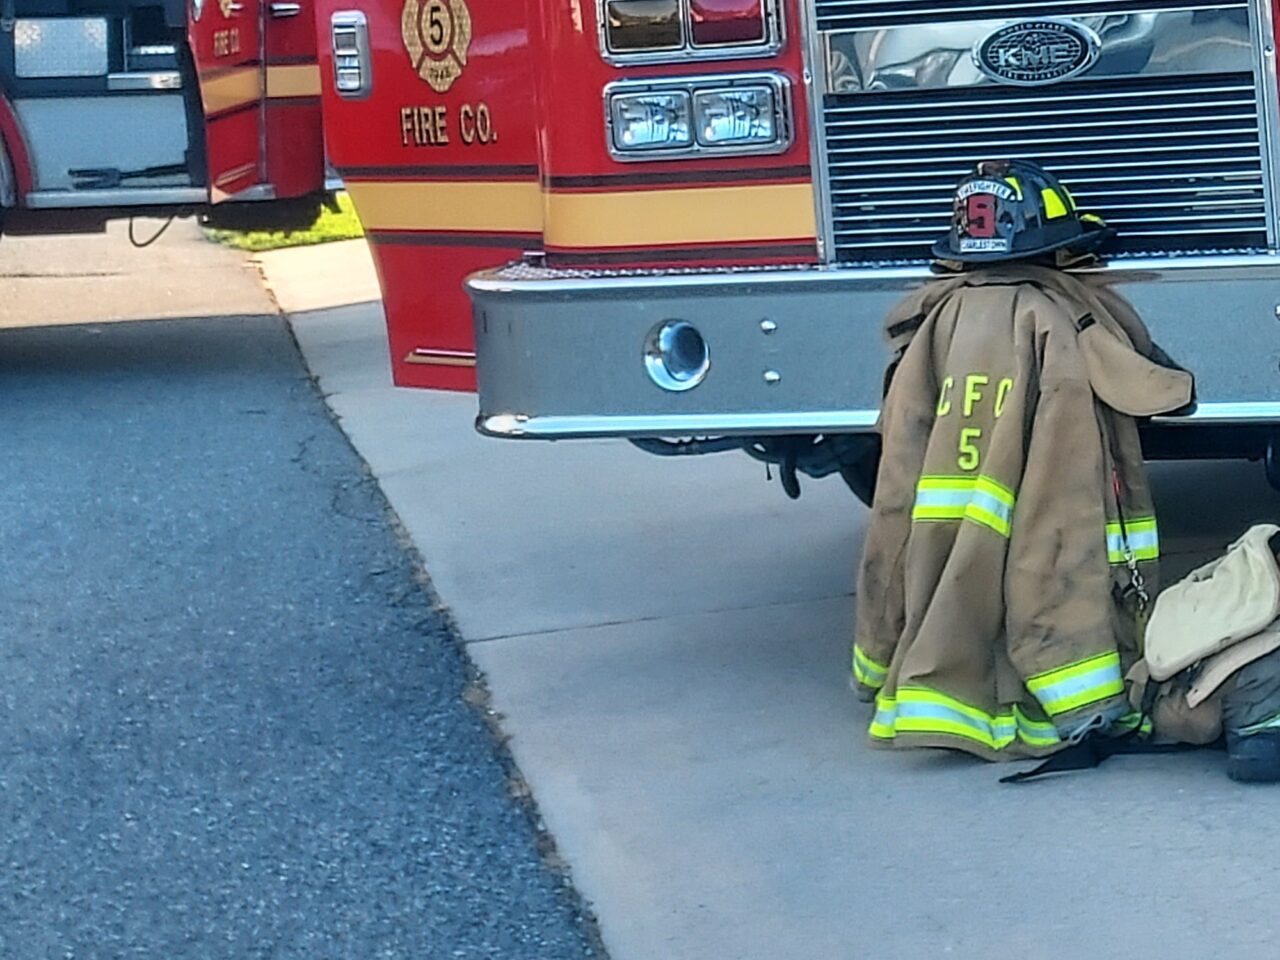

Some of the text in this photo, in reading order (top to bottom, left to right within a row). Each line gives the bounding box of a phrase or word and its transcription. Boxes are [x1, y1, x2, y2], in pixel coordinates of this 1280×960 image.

[430, 5, 444, 46] 5
[998, 43, 1071, 65] KME
[401, 103, 498, 146] FIRE CO.
[968, 195, 996, 237] 5
[958, 428, 981, 470] 5
